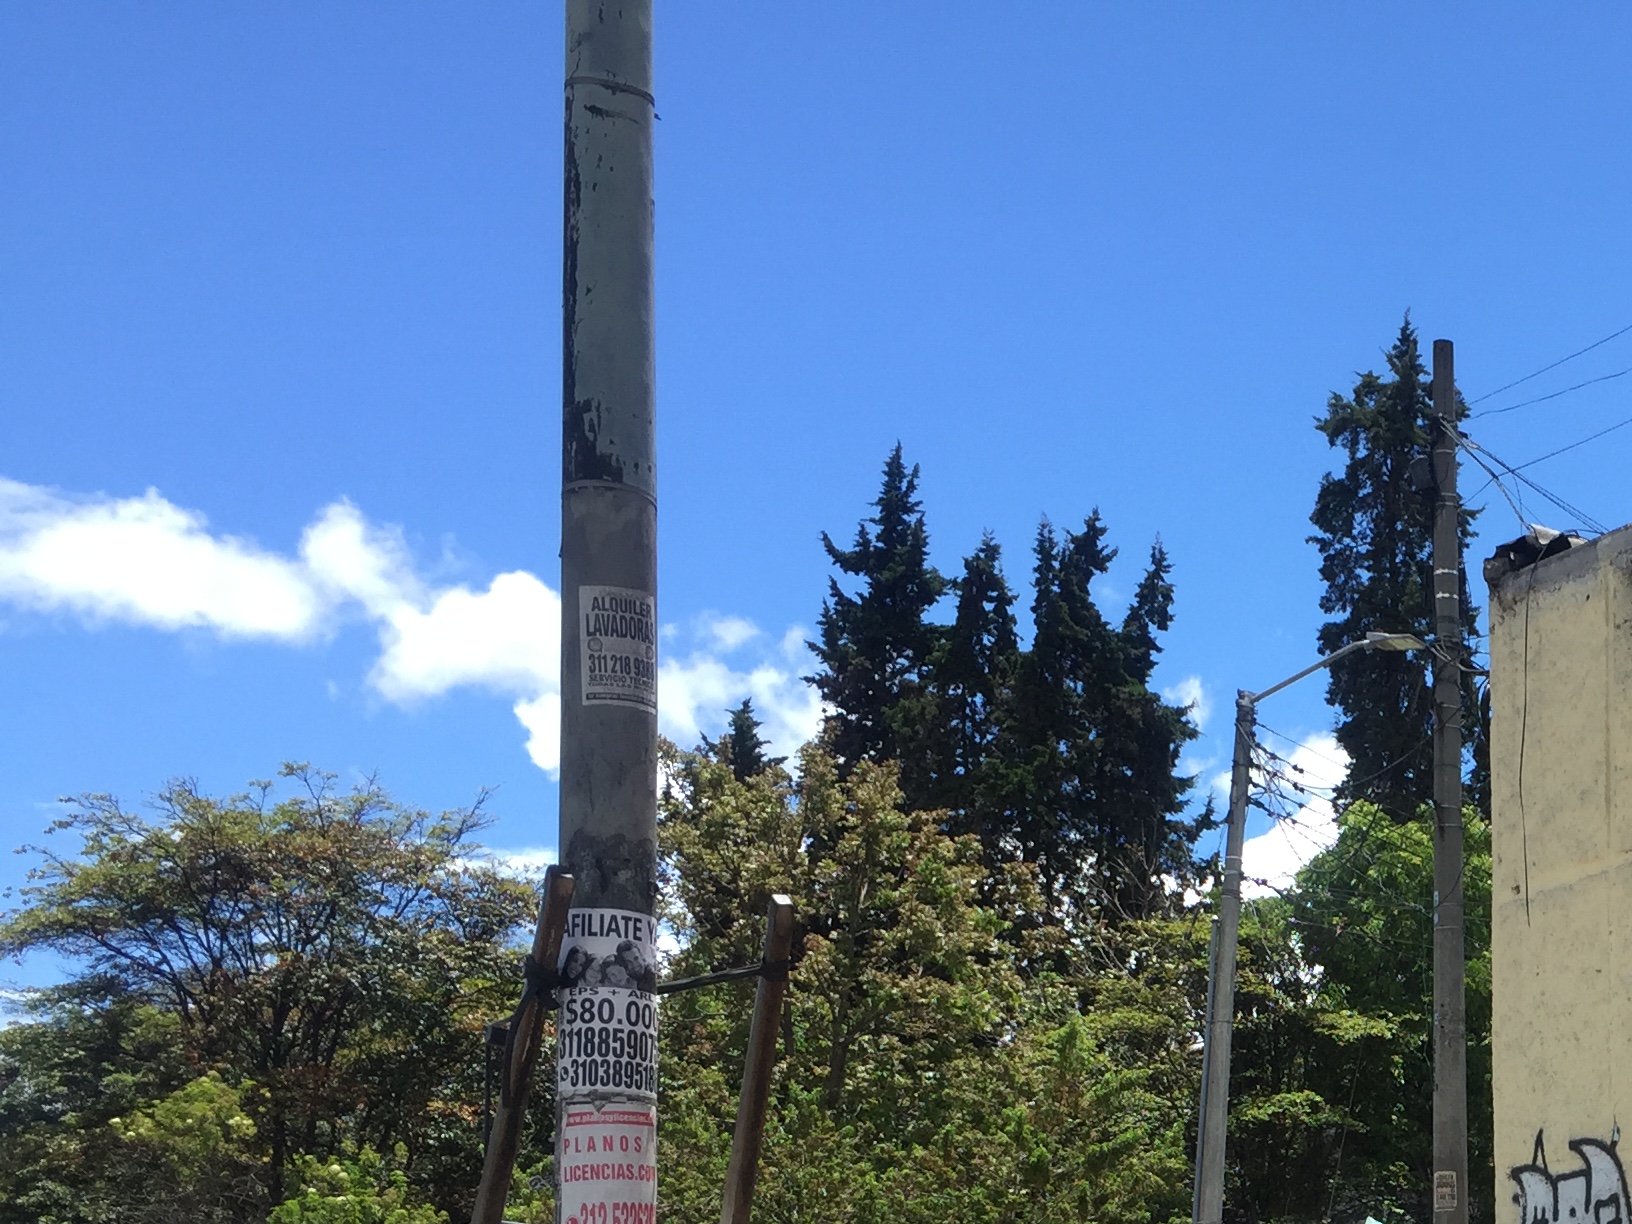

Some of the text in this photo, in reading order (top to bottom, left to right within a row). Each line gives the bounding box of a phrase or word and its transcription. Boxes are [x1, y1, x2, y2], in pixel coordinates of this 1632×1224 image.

[591, 596, 652, 620] ALQUILER
[586, 613, 654, 646] LAVADORAS
[588, 653, 608, 673] 311
[610, 654, 631, 675] 218
[569, 986, 599, 996] EPS
[560, 1026, 657, 1063] 311885907
[570, 1058, 656, 1093] 310389518
[563, 1134, 642, 1155] PLANOS
